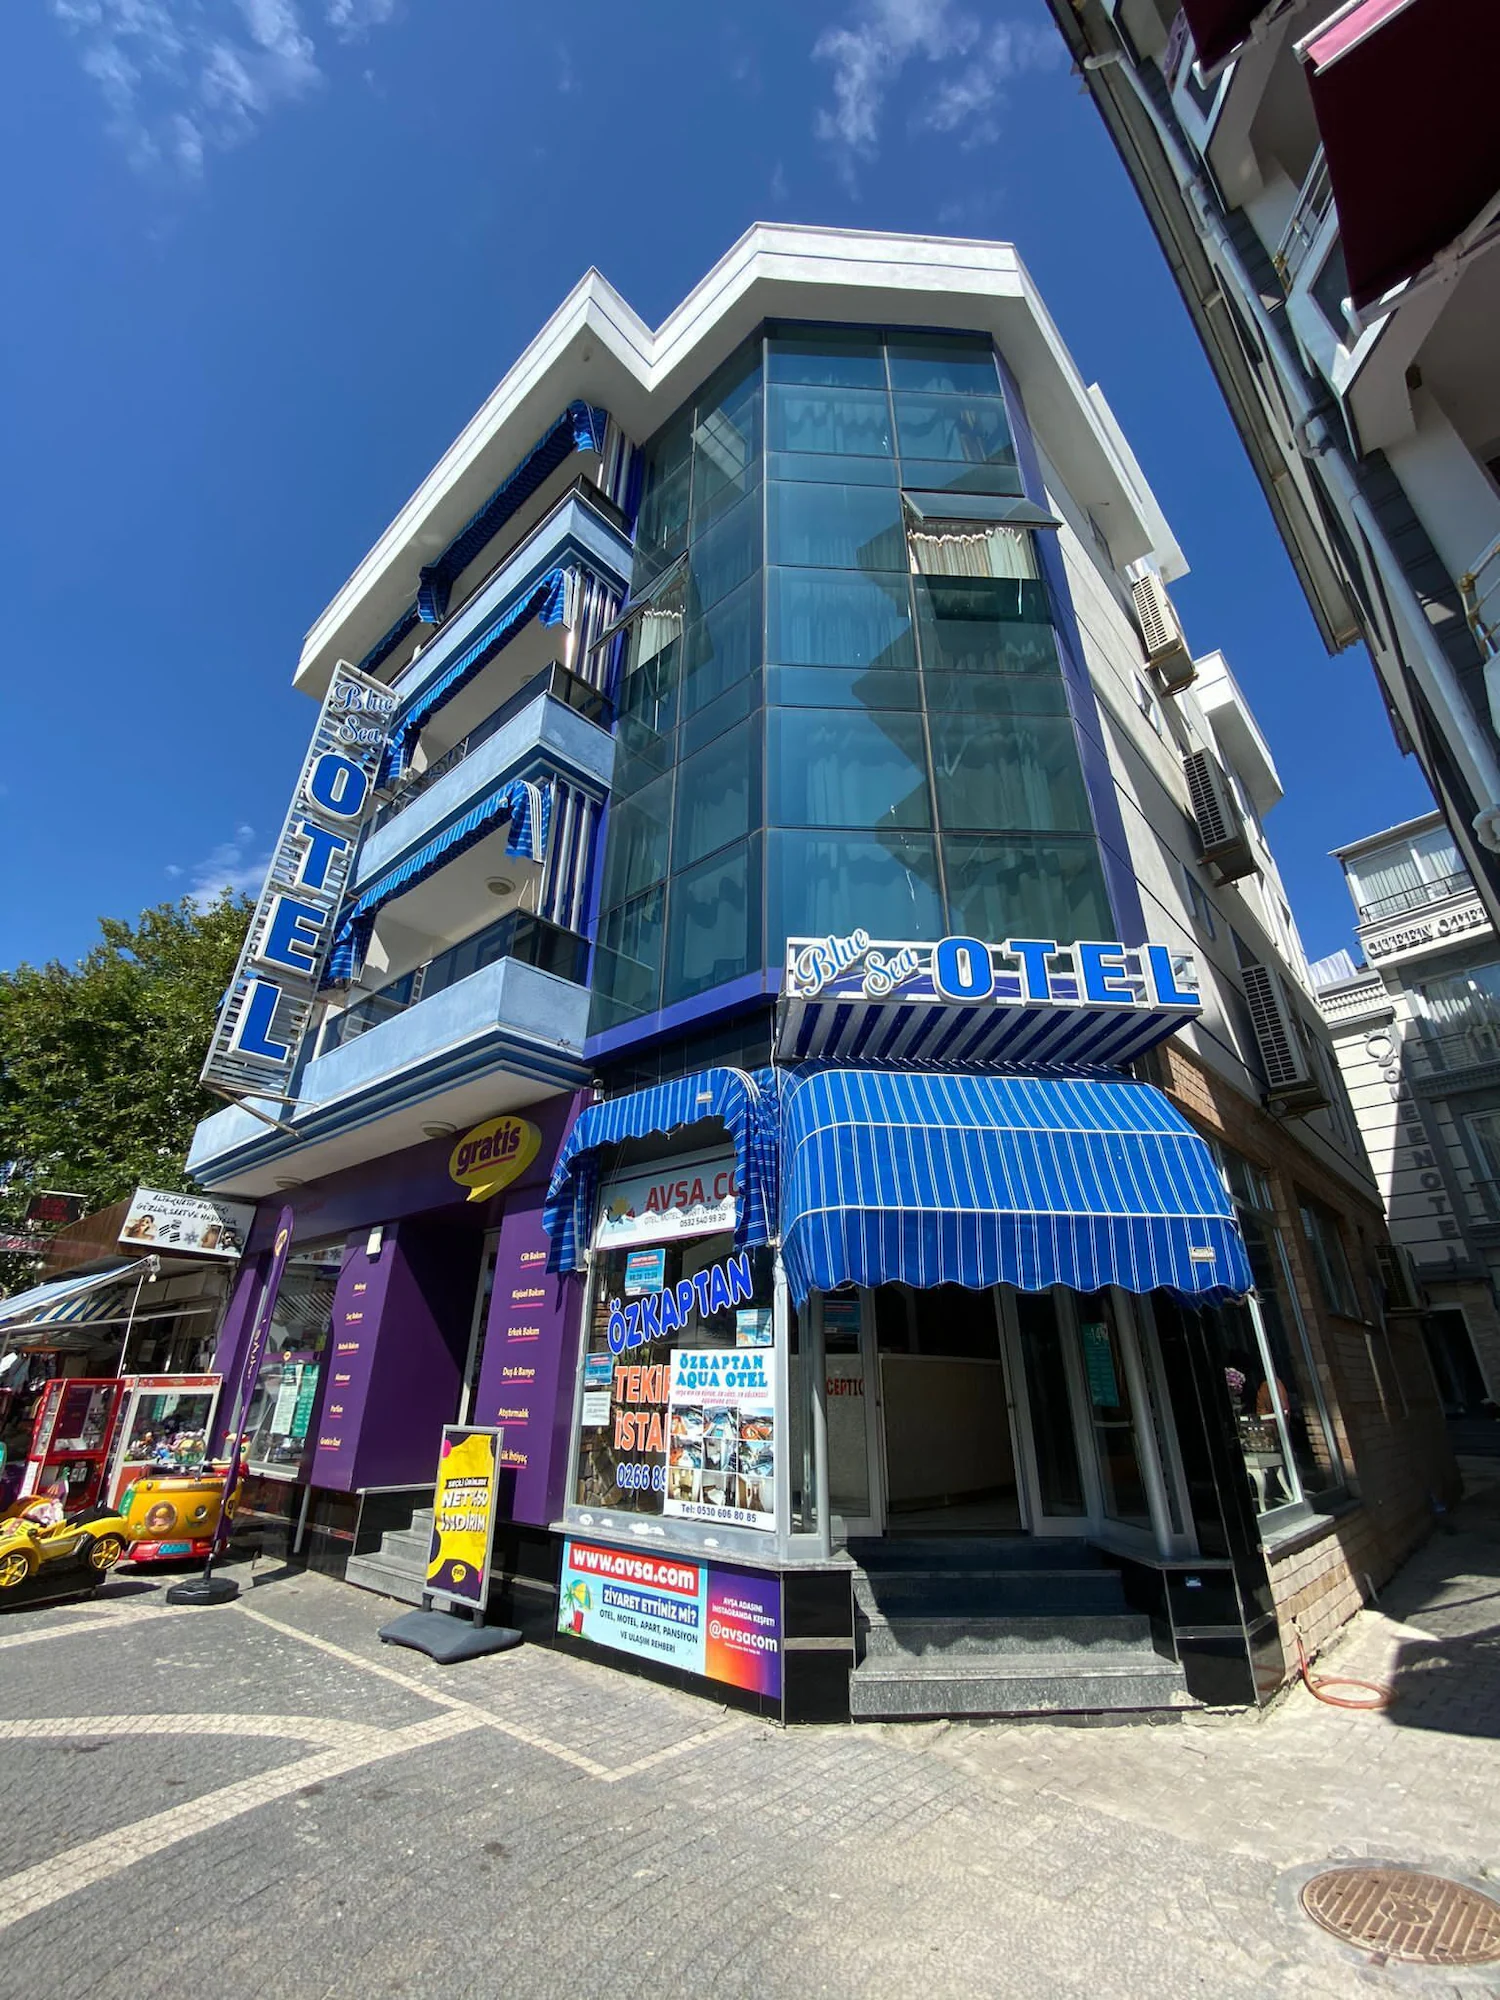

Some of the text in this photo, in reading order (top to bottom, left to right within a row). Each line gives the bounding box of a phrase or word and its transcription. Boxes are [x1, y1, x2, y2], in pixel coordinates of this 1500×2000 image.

[333, 679, 398, 714] Blue
[338, 714, 381, 745] Sea
[228, 751, 369, 1064] OTEL
[795, 927, 1203, 1010] Blue Sea OTEL
[456, 1120, 521, 1177] gratis
[607, 1252, 753, 1355] ÖZKAPTAN
[680, 1353, 764, 1370] ÖZKAPTAN
[675, 1371, 768, 1389] AQUA OTEL
[616, 1462, 650, 1490] 0266
[442, 1491, 469, 1508] NET
[681, 1504, 696, 1514] Tel:
[697, 1505, 716, 1518] 0530
[439, 1509, 486, 1533] İNDİRİM
[573, 1548, 695, 1590] www.avsa.com
[603, 1586, 697, 1625] ZİYARET ETTİNİZ Mİ?
[599, 1609, 616, 1623] OTEL,
[617, 1613, 639, 1629] MOTEL,
[640, 1620, 662, 1634] APART,
[620, 1630, 628, 1640] VE
[709, 1619, 778, 1653] @avsacom
